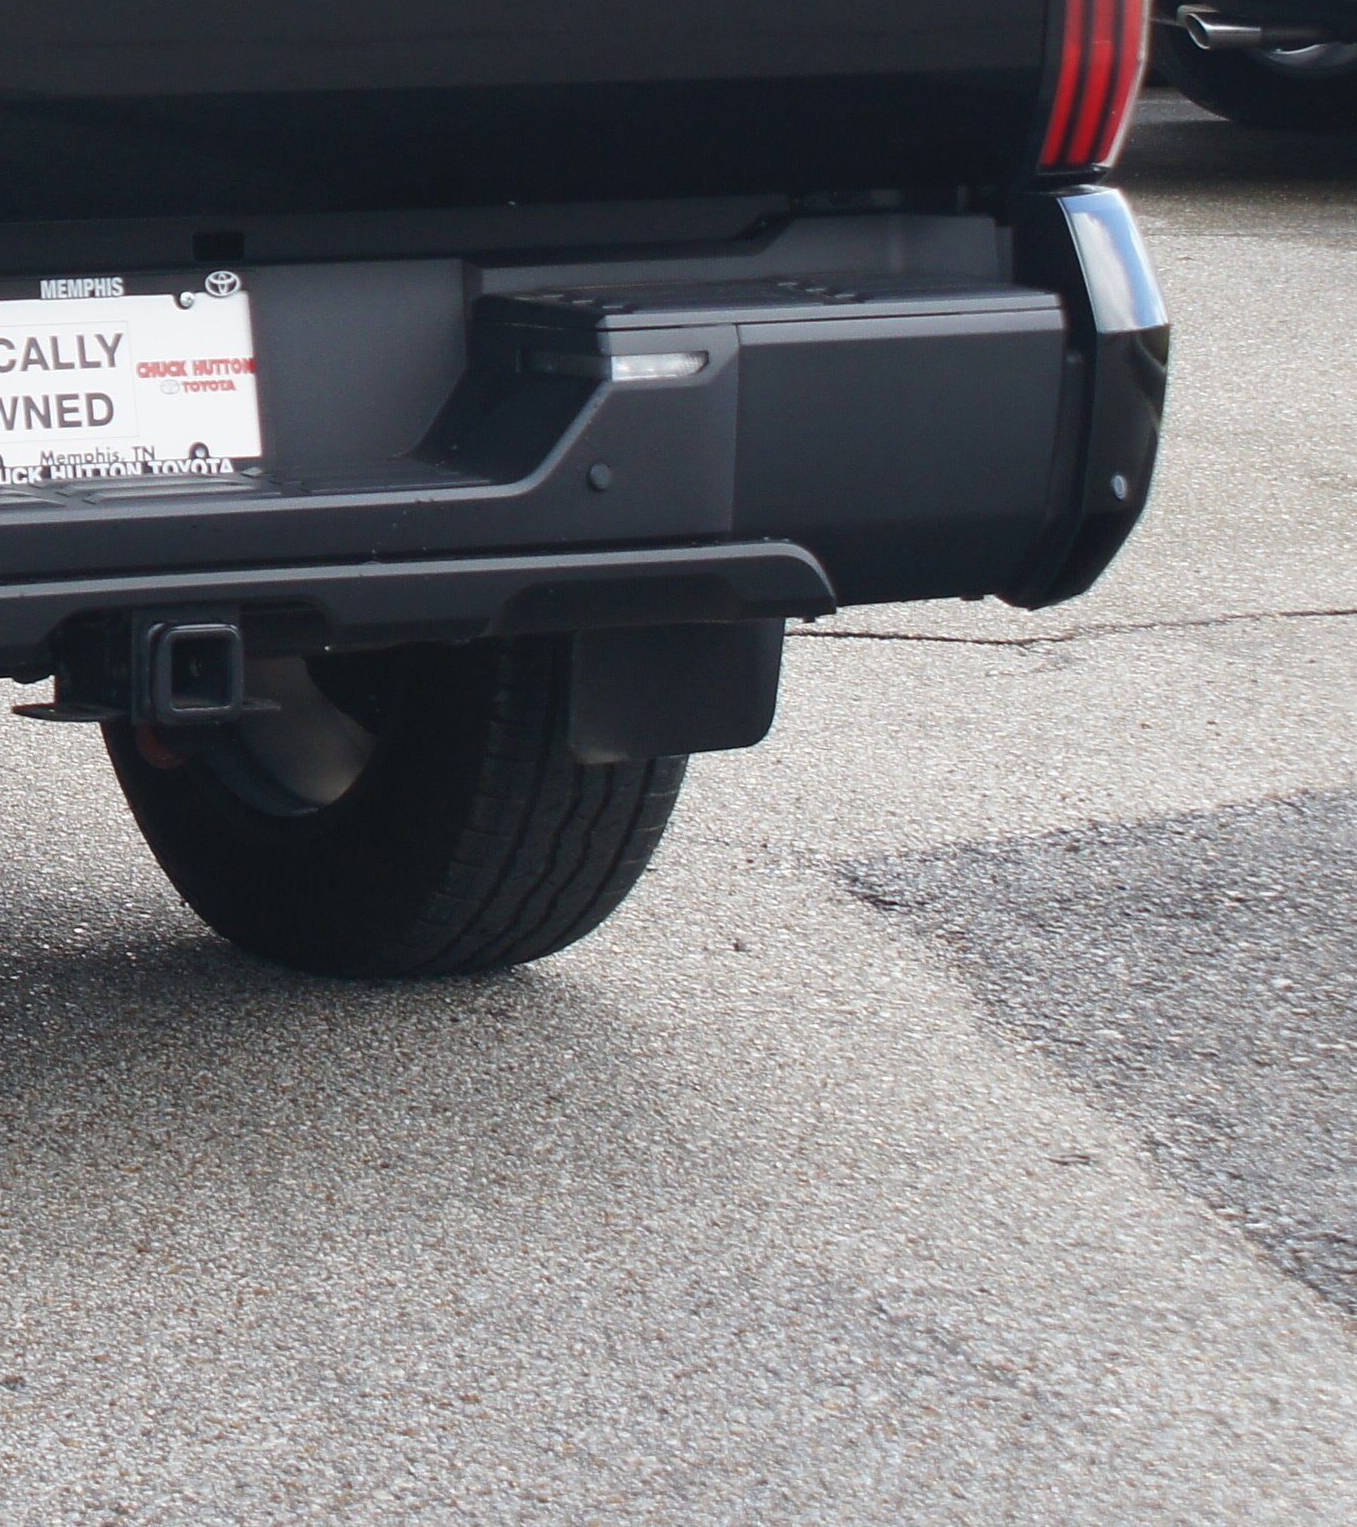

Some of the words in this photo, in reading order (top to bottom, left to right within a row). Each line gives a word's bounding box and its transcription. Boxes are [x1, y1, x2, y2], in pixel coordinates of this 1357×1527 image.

[40, 277, 125, 300] MEMPHIS
[135, 360, 188, 379] CHUCK
[191, 357, 258, 377] HUTTON
[180, 379, 237, 393] TOYOTA
[131, 444, 156, 461] TN
[50, 459, 143, 480] HUTTON
[147, 457, 235, 474] TOYOTA
